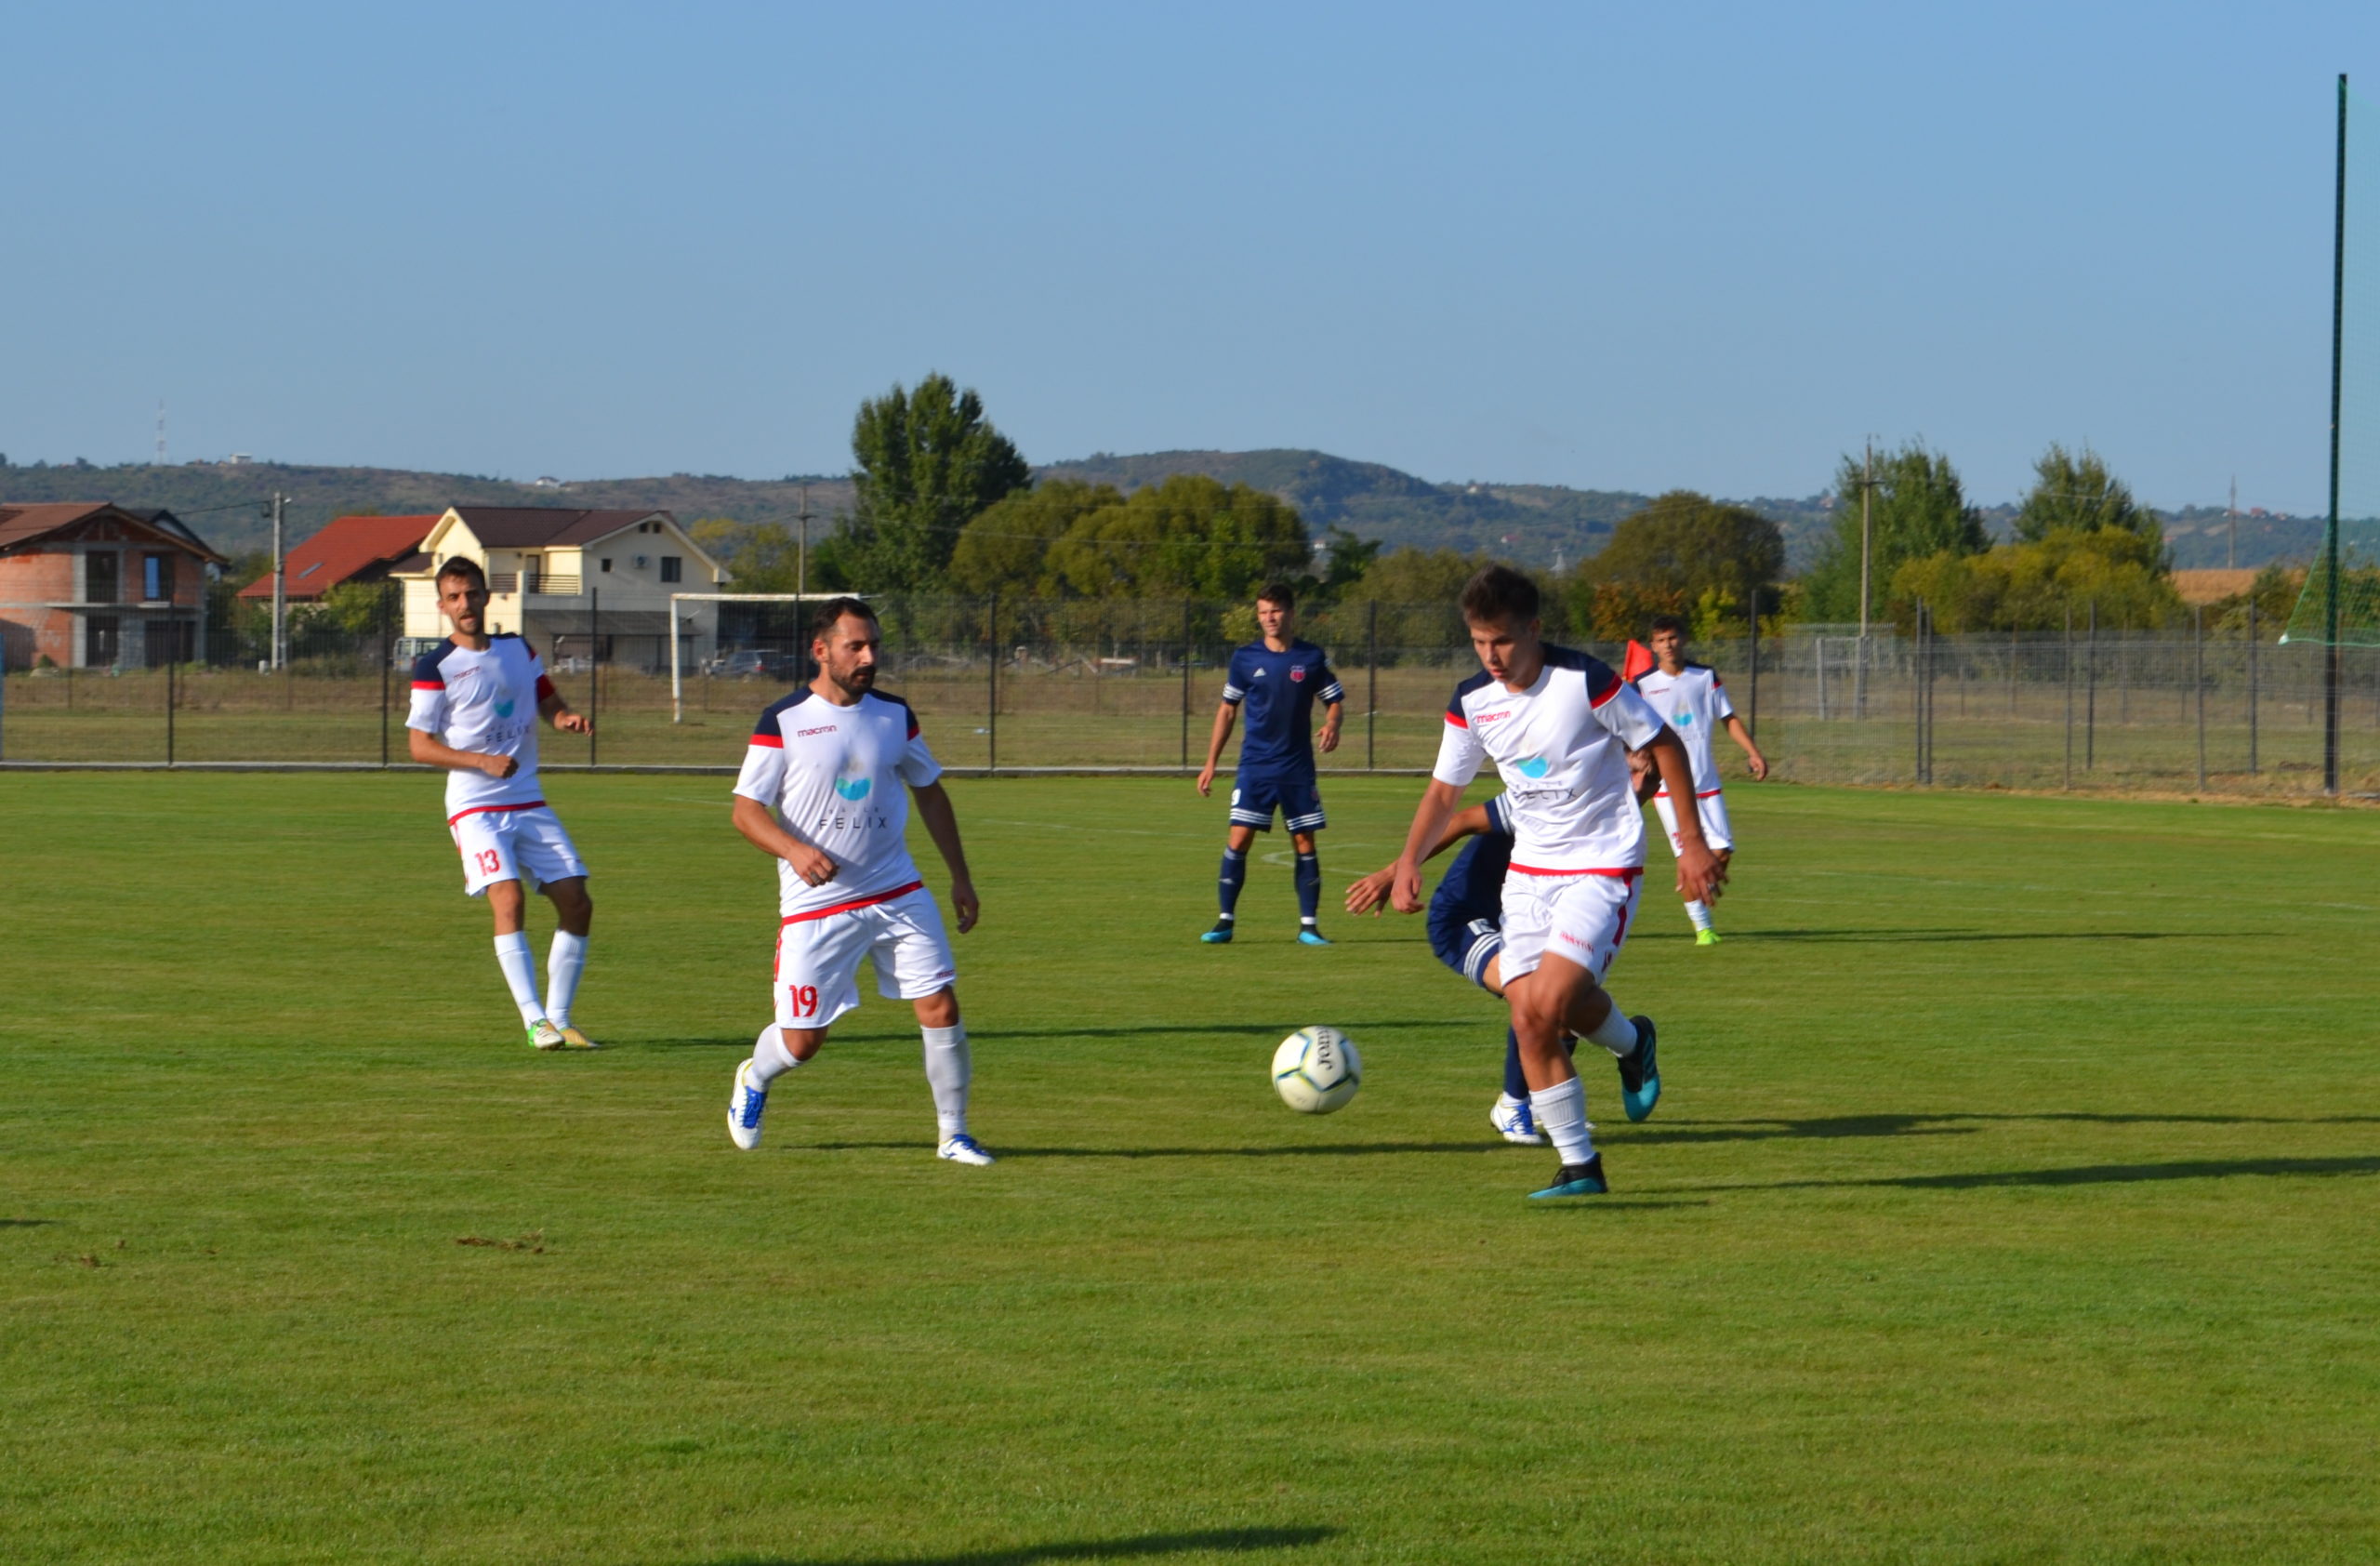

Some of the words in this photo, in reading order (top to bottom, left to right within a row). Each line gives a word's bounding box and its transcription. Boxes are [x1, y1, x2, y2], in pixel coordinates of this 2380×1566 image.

[819, 816, 888, 830] FELIX
[474, 848, 501, 877] 13
[788, 984, 818, 1017] 19
